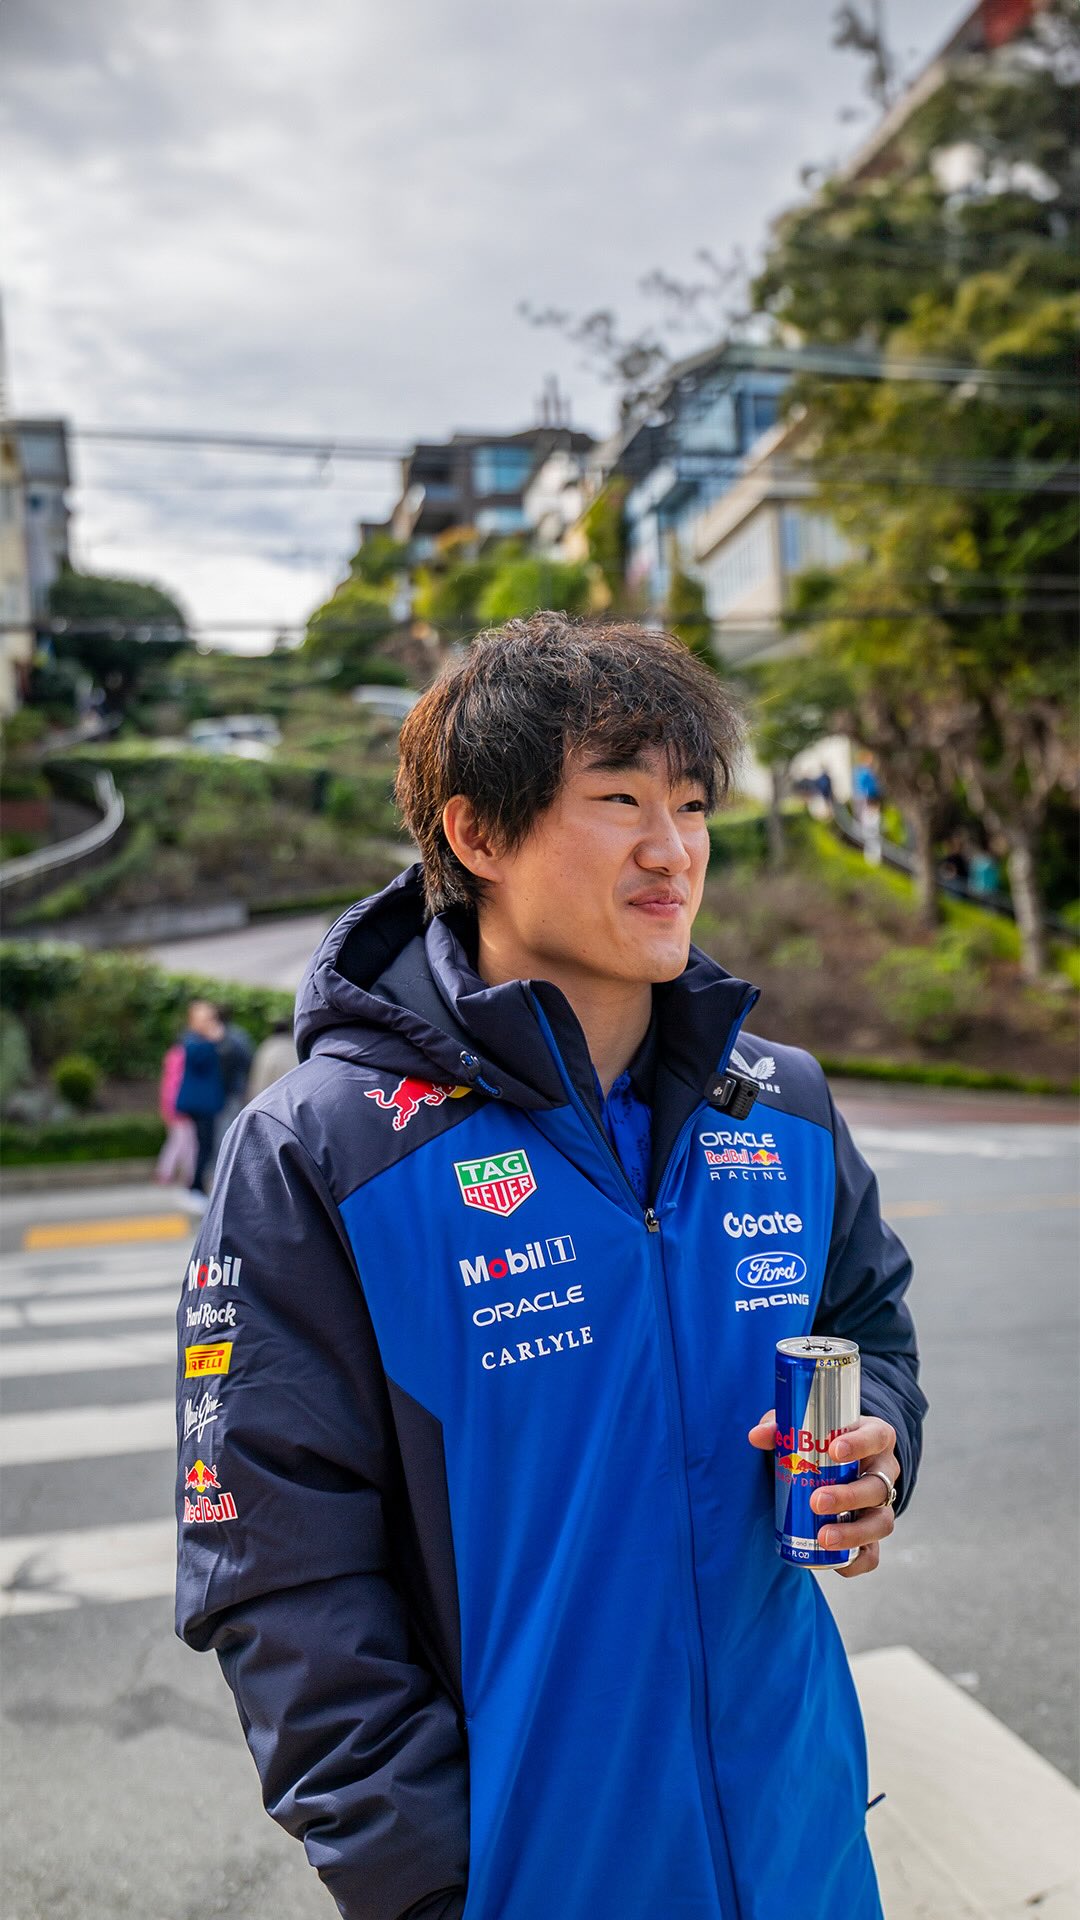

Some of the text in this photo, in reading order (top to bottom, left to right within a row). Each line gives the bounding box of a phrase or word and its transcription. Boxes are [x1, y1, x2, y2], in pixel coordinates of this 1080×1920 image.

[700, 1131, 776, 1148] ORACLE
[461, 1155, 524, 1183] TAG
[704, 1150, 750, 1165] Red Bull
[710, 1171, 787, 1181] RACING
[466, 1177, 531, 1212] HEUER
[188, 1255, 242, 1291] Mobil
[459, 1241, 546, 1287] Mobil
[747, 1256, 798, 1284] Ford
[201, 1302, 237, 1328] Rock
[472, 1284, 585, 1327] ORACLE
[735, 1293, 810, 1312] RACING
[481, 1326, 594, 1370] CARLYLE
[188, 1358, 223, 1371] IRELLI
[775, 1427, 795, 1451] ed
[183, 1491, 238, 1523] Red Bull
